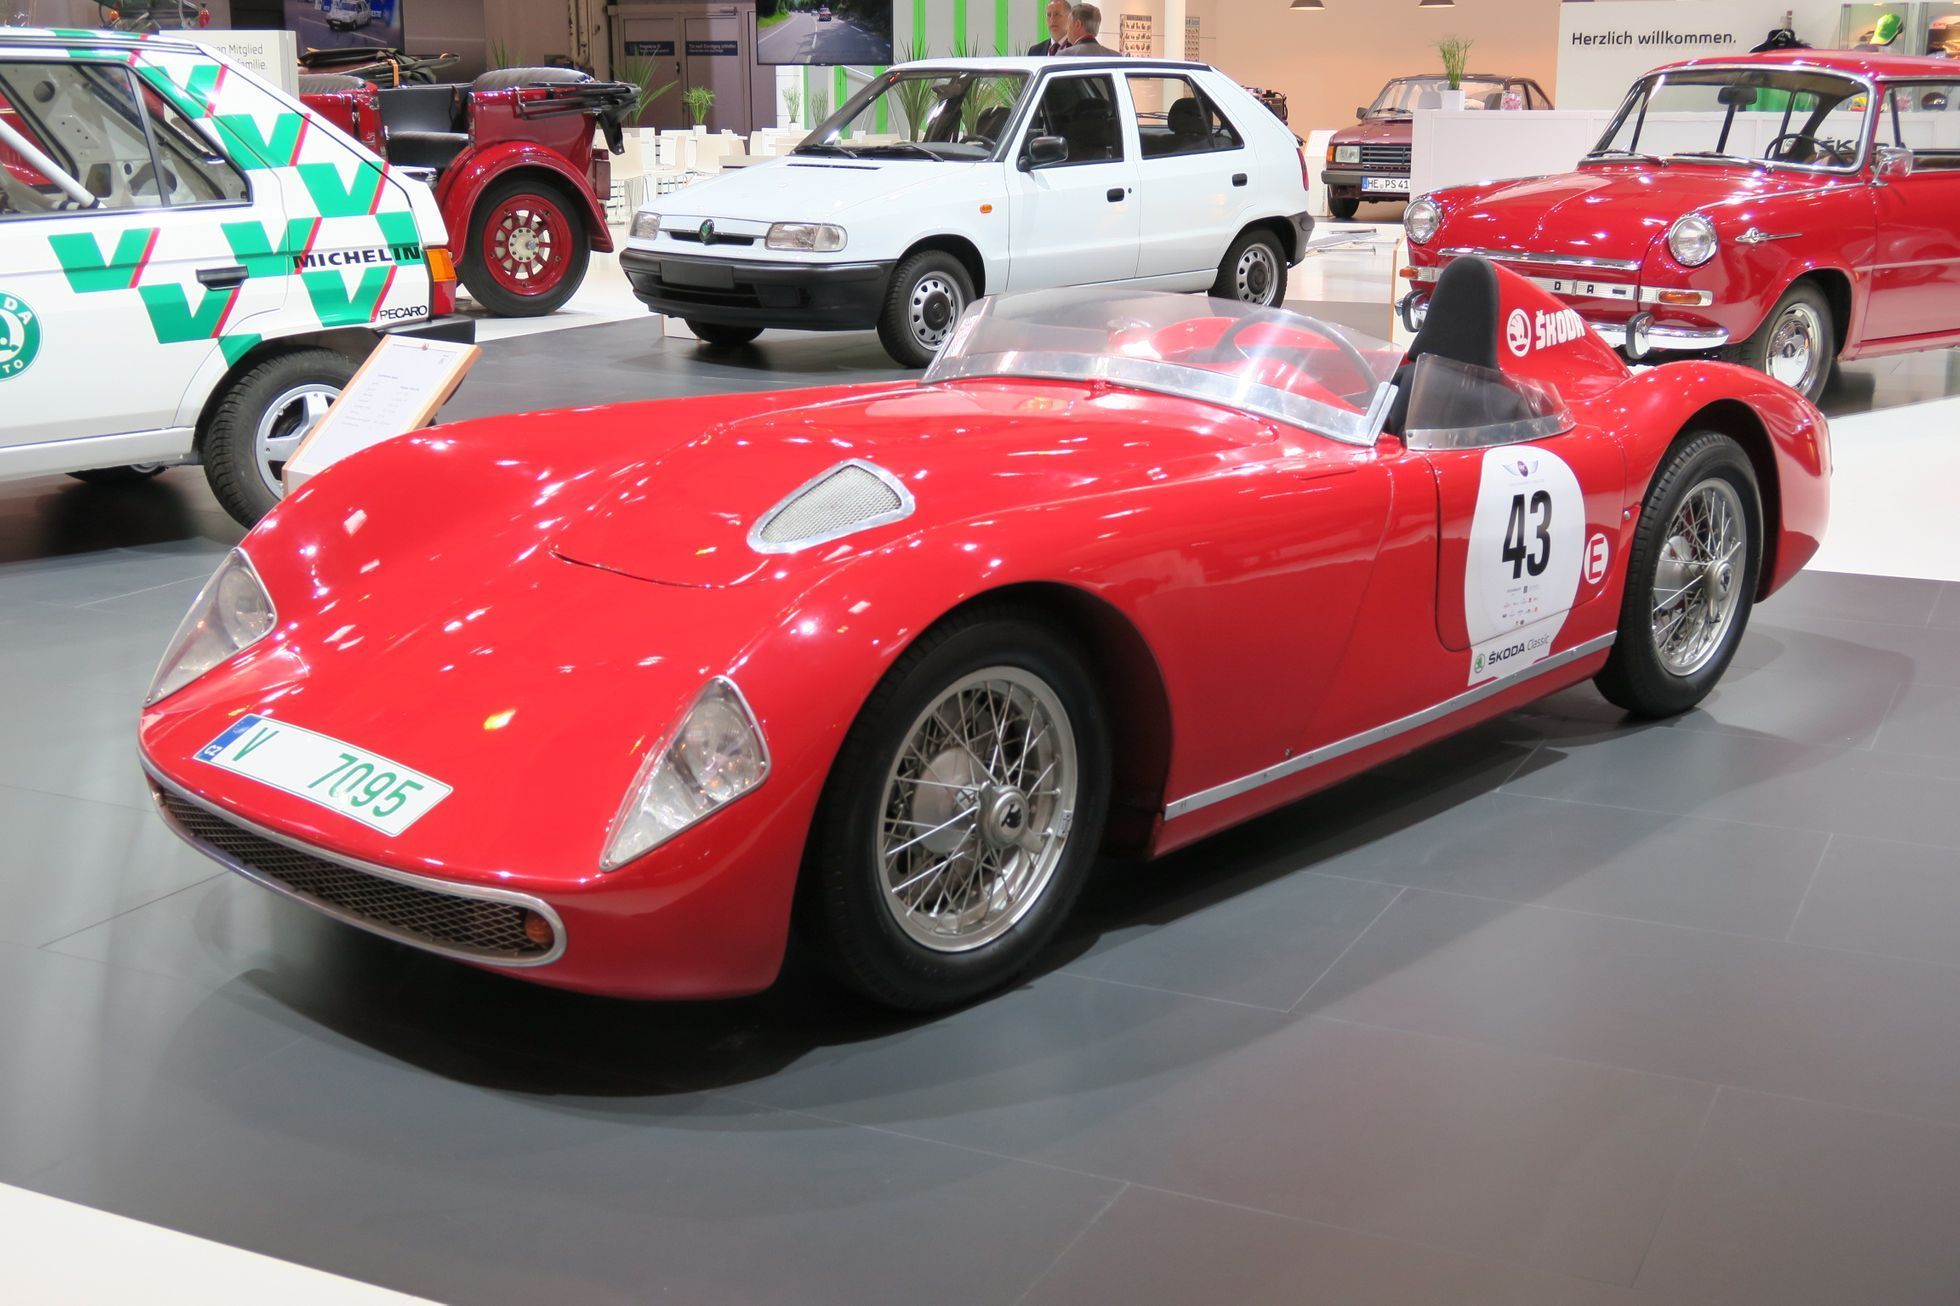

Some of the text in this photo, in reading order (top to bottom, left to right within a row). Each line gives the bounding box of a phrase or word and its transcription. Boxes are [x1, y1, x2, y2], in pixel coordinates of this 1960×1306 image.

[229, 43, 263, 57] Mitglied
[1572, 31, 1737, 45] Herzlich willkommen.
[1368, 179, 1379, 189] HE
[1385, 179, 1397, 189] PS
[292, 246, 421, 269] MICHELIN
[1536, 309, 1586, 350] ŠKODA
[1502, 490, 1552, 580] 43
[1589, 537, 1605, 580] E
[1488, 633, 1550, 665] ŠKODA Classic
[204, 727, 425, 817] CZ V 7095
